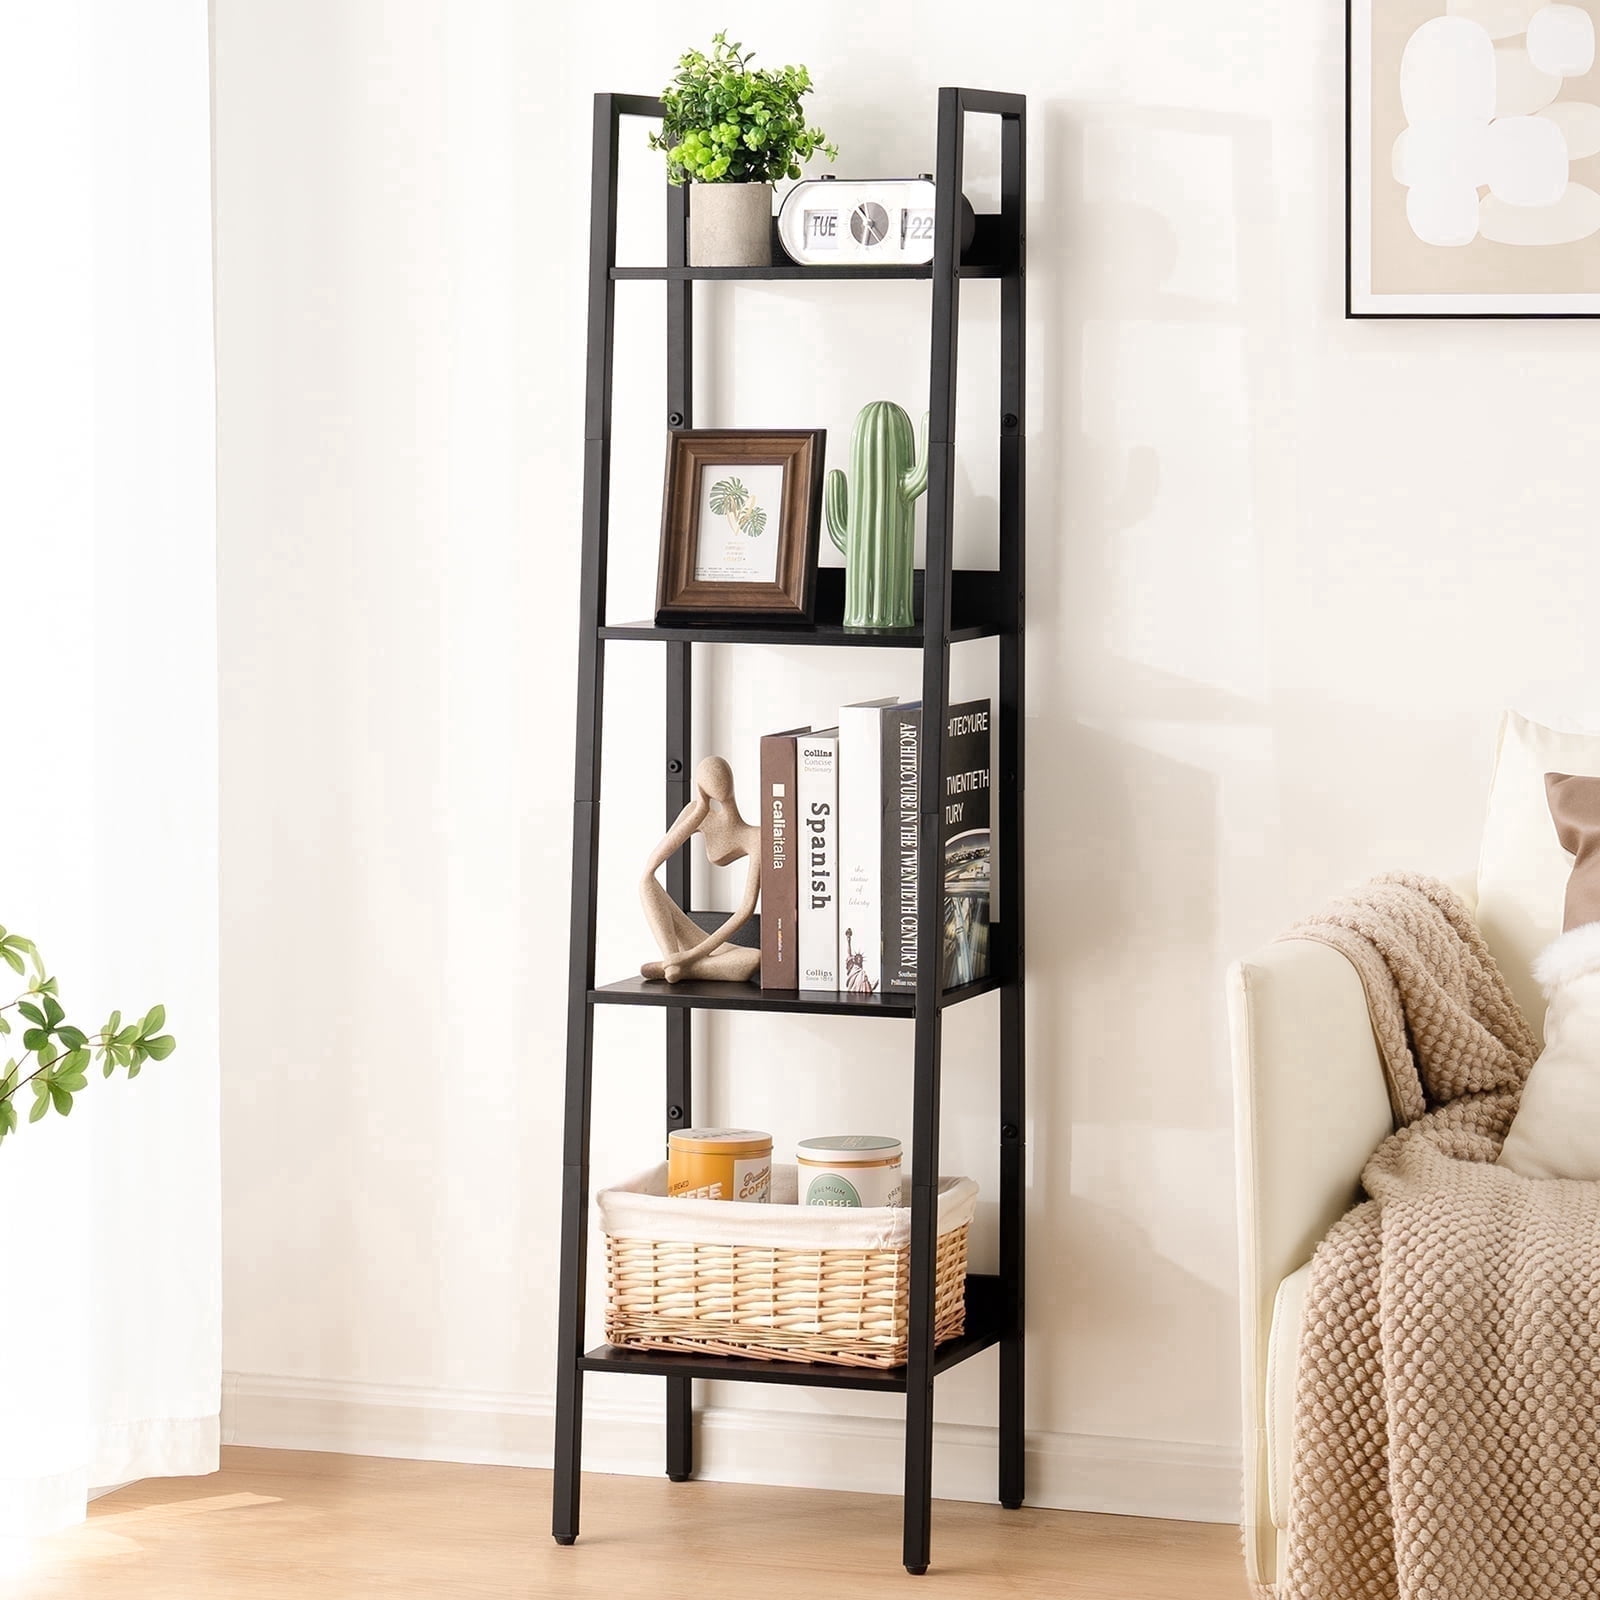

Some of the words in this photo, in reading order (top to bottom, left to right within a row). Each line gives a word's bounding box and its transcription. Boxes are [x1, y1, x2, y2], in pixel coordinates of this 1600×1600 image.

[812, 215, 838, 237] TUE
[910, 216, 934, 240] 22
[947, 711, 989, 738] HITECYURE
[803, 749, 833, 758] Collins
[804, 758, 833, 767] Concise
[899, 722, 918, 810] ARCHITECYURE
[946, 768, 990, 796] TWENTIETH
[900, 811, 918, 823] IN
[945, 802, 965, 825] TURY
[772, 800, 786, 869] caliaitalia
[900, 824, 918, 848] THE
[806, 802, 832, 910] Spanish
[900, 849, 918, 914] TWENTIETH
[900, 916, 919, 969] CENTURY
[805, 969, 833, 977] Collins
[814, 1185, 846, 1197] PREMIUM
